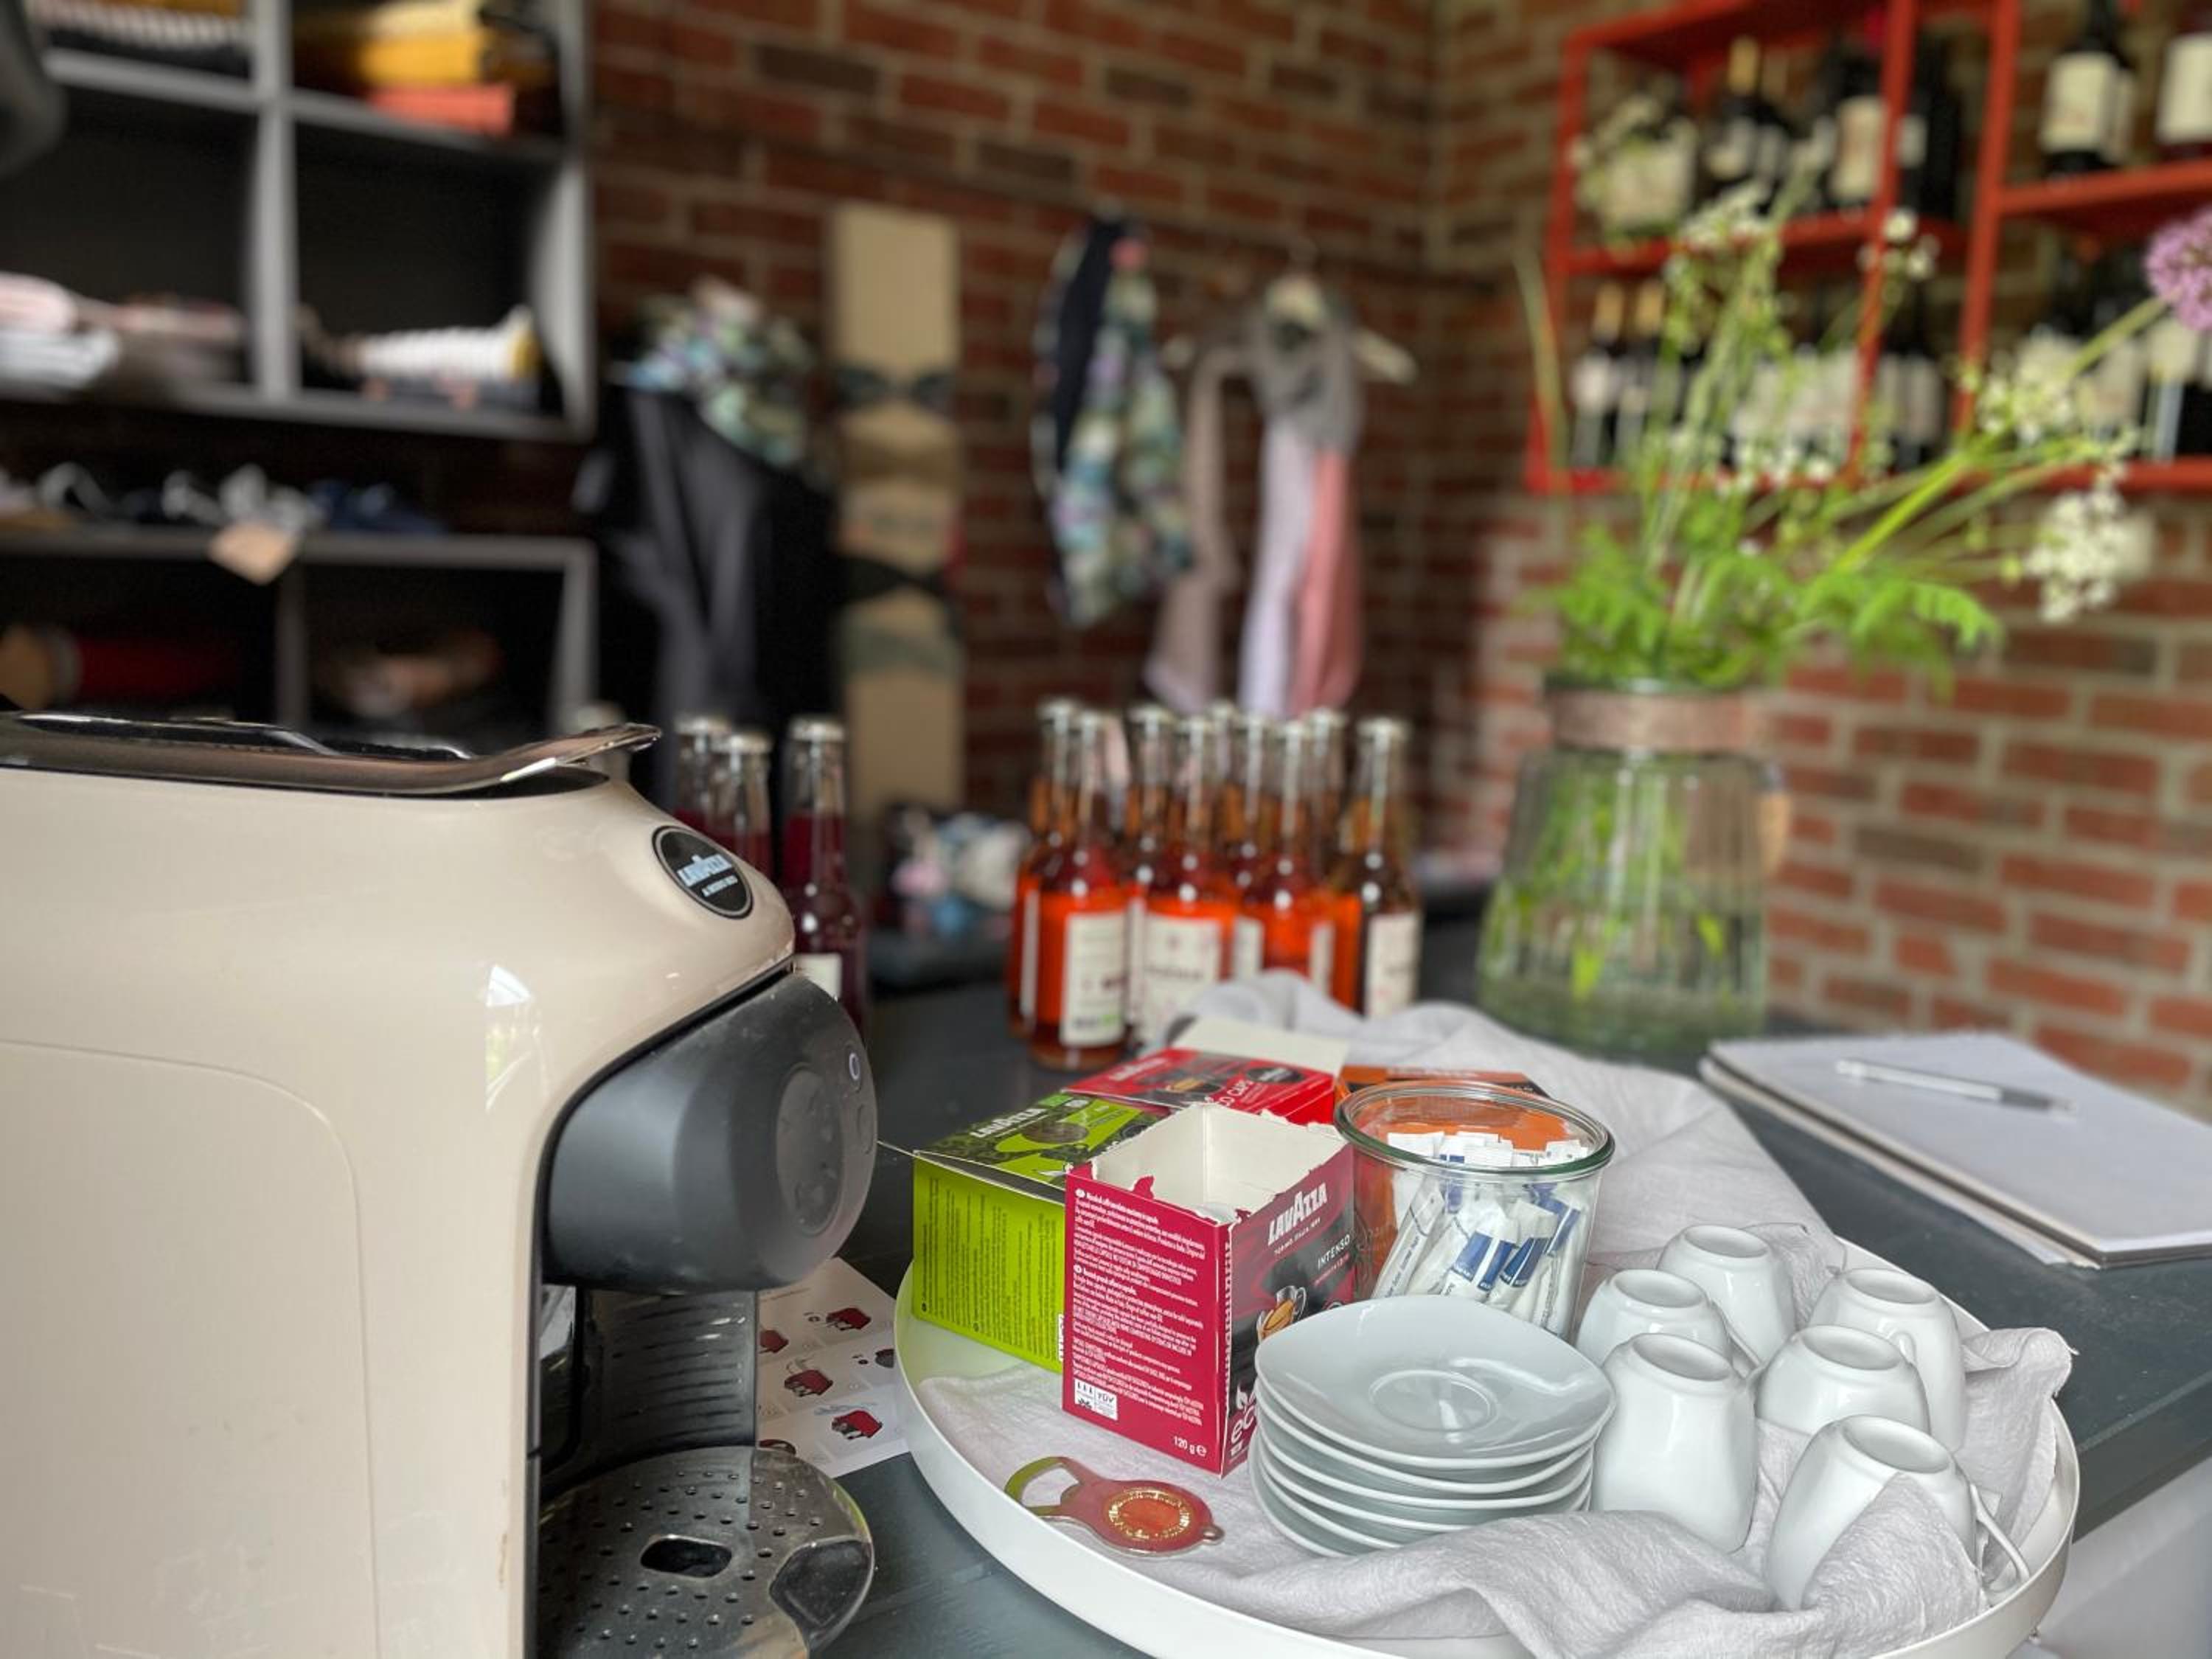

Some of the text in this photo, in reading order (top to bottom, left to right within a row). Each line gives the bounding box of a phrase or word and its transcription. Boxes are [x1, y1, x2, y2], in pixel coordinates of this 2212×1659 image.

[1267, 1182, 1327, 1246] LAVAZZA
[1318, 1234, 1350, 1270] INTENSO
[1174, 1436, 1188, 1450] 120
